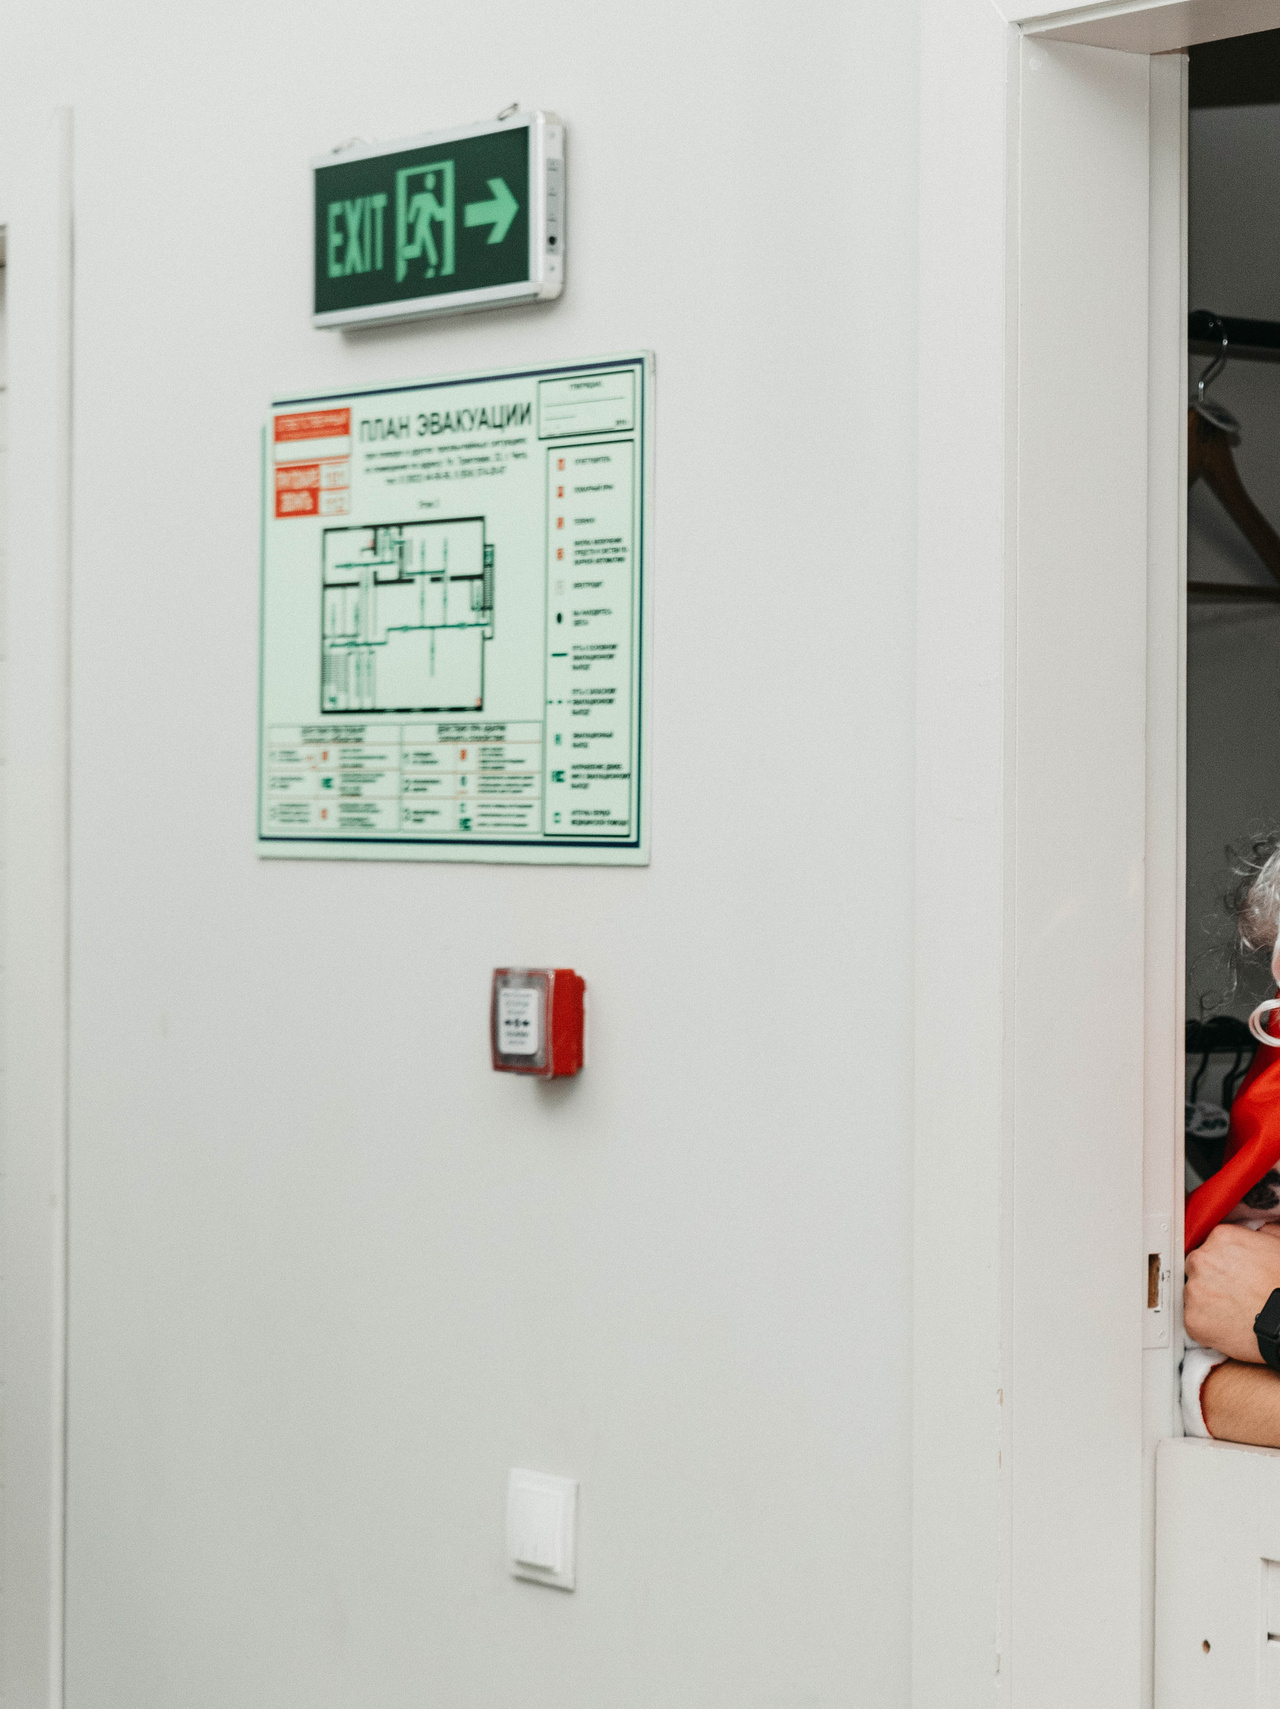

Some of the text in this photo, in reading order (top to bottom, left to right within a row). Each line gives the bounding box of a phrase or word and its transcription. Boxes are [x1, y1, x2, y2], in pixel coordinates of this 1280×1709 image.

[327, 193, 388, 279] EXIT
[360, 415, 411, 443] ПЛАН
[416, 401, 532, 437] ЭВАКУАЦИИ
